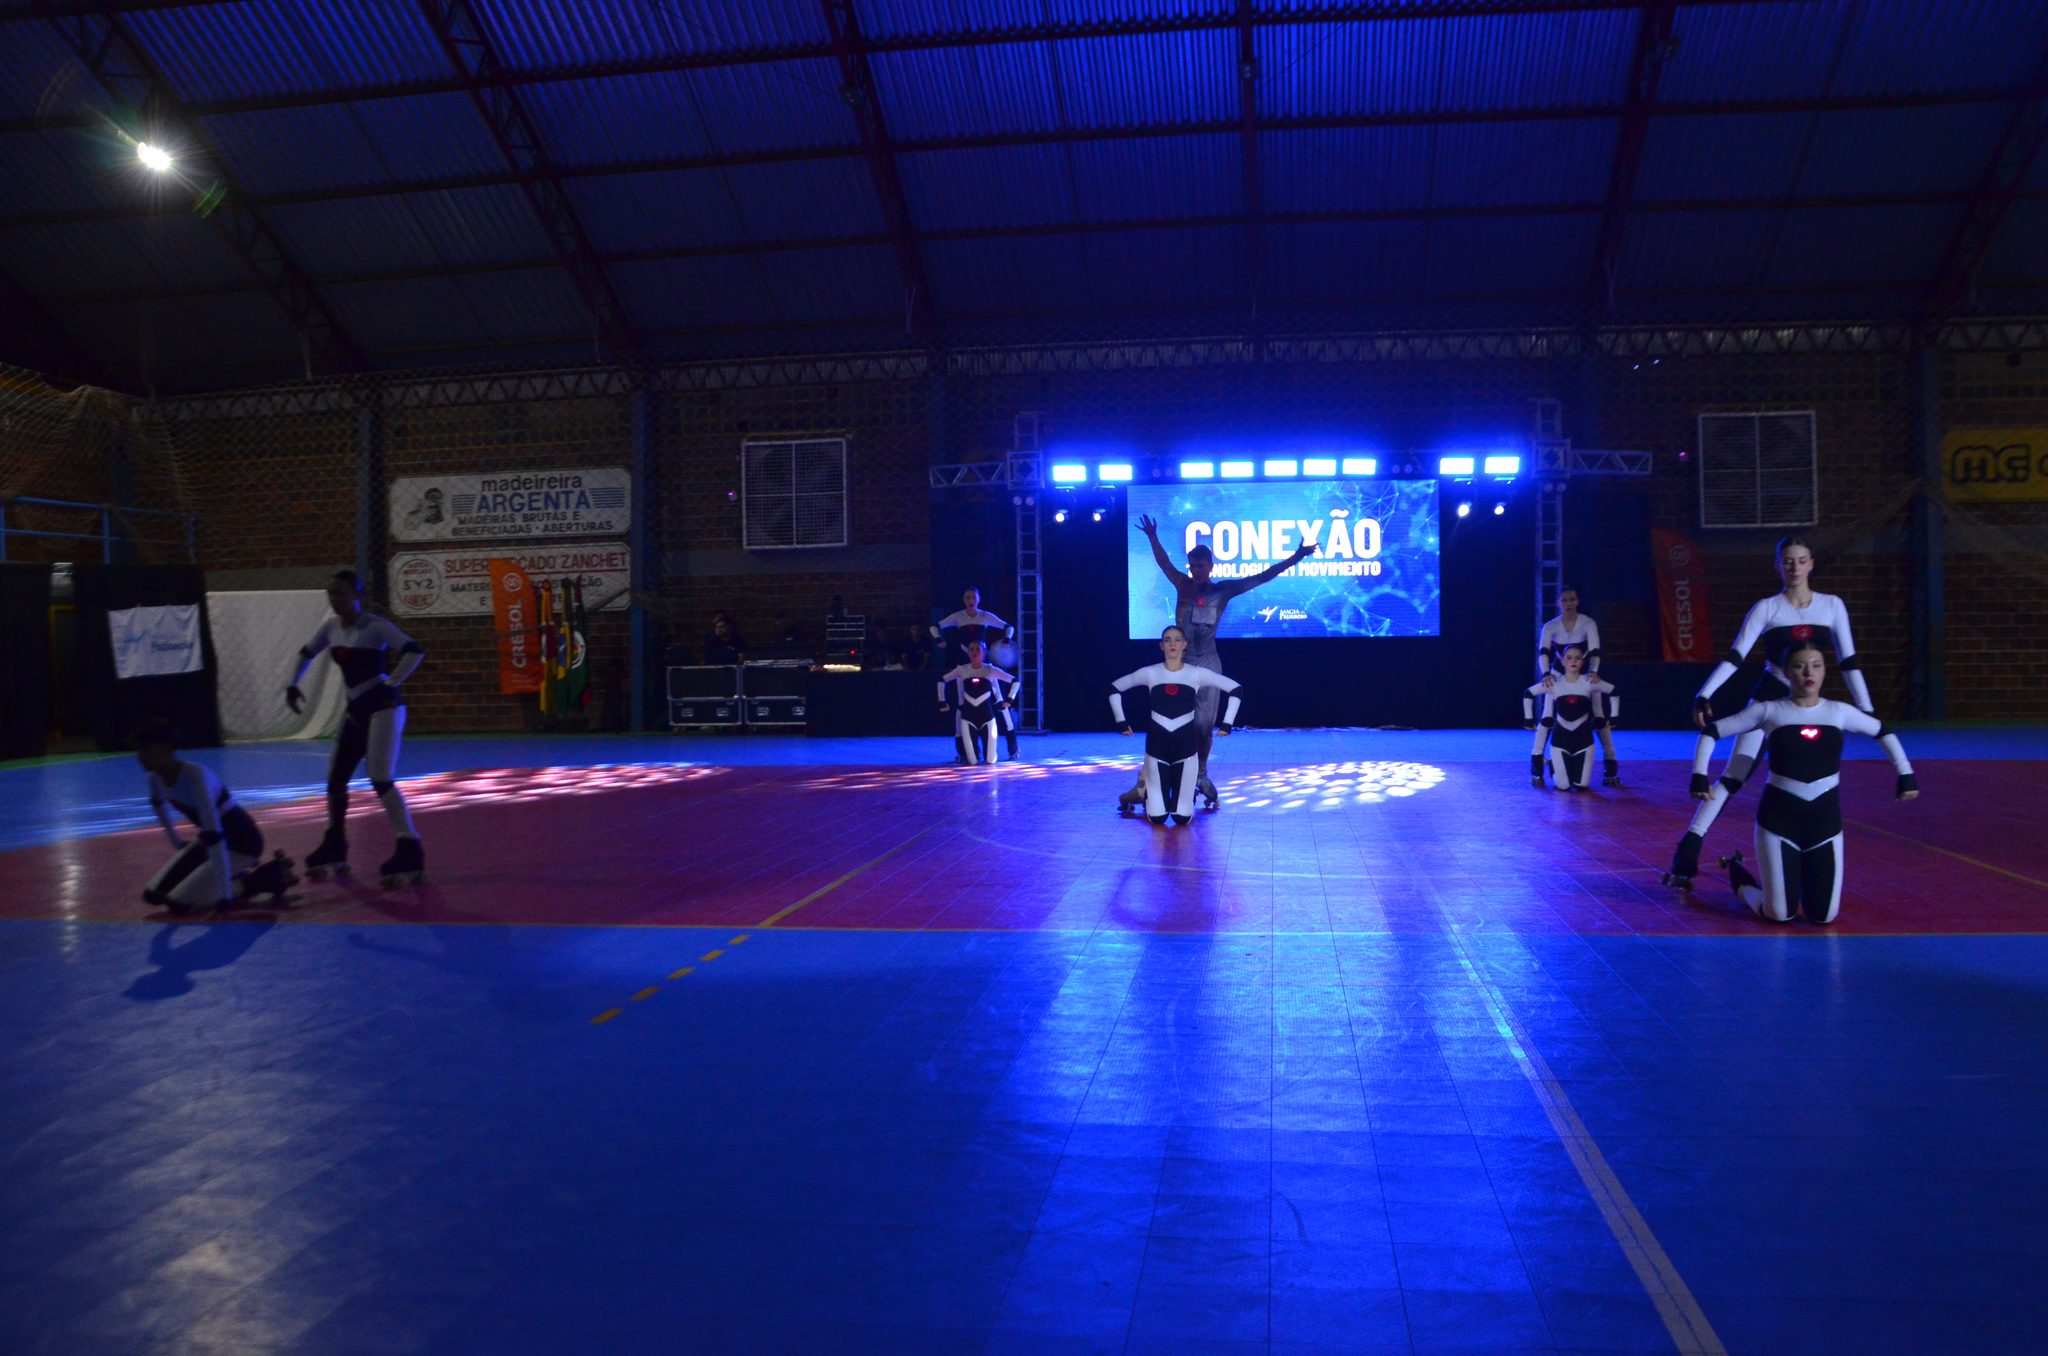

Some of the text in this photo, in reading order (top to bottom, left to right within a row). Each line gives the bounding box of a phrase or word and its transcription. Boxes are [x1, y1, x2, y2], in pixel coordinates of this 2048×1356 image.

[482, 474, 582, 491] madeireira
[477, 490, 591, 513] ARGENTA
[458, 511, 580, 525] MADEIRAS BRUTAS E
[543, 520, 613, 532] ABERTURAS
[1185, 508, 1381, 561] CONEXÃO
[561, 552, 628, 569] ZANCHET
[1298, 561, 1381, 577] MOVIMENTO
[1674, 577, 1695, 651] CRESOL
[508, 600, 527, 669] CRESOL
